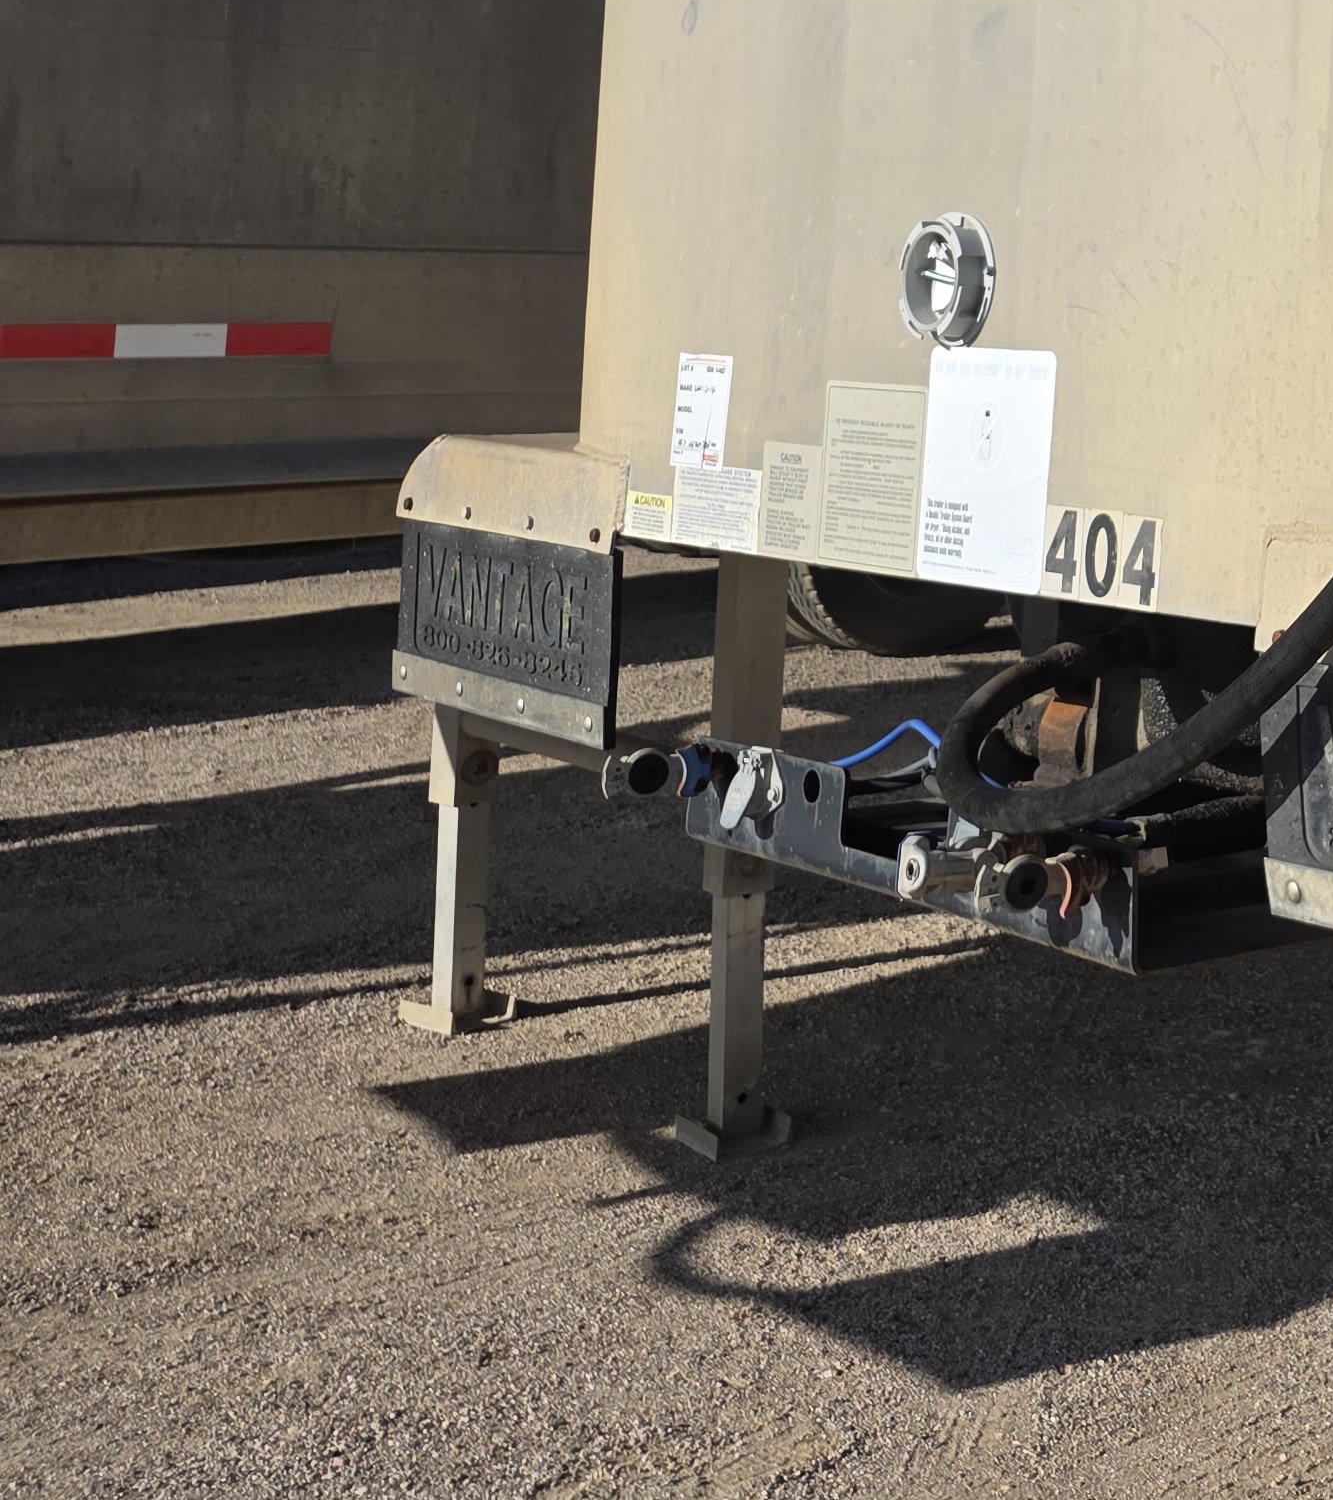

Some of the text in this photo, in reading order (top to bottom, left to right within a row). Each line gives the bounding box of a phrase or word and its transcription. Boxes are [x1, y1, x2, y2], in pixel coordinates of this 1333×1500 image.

[640, 495, 665, 508] CAUTION
[424, 543, 588, 656] VANTAGE
[1044, 509, 1158, 607] 404
